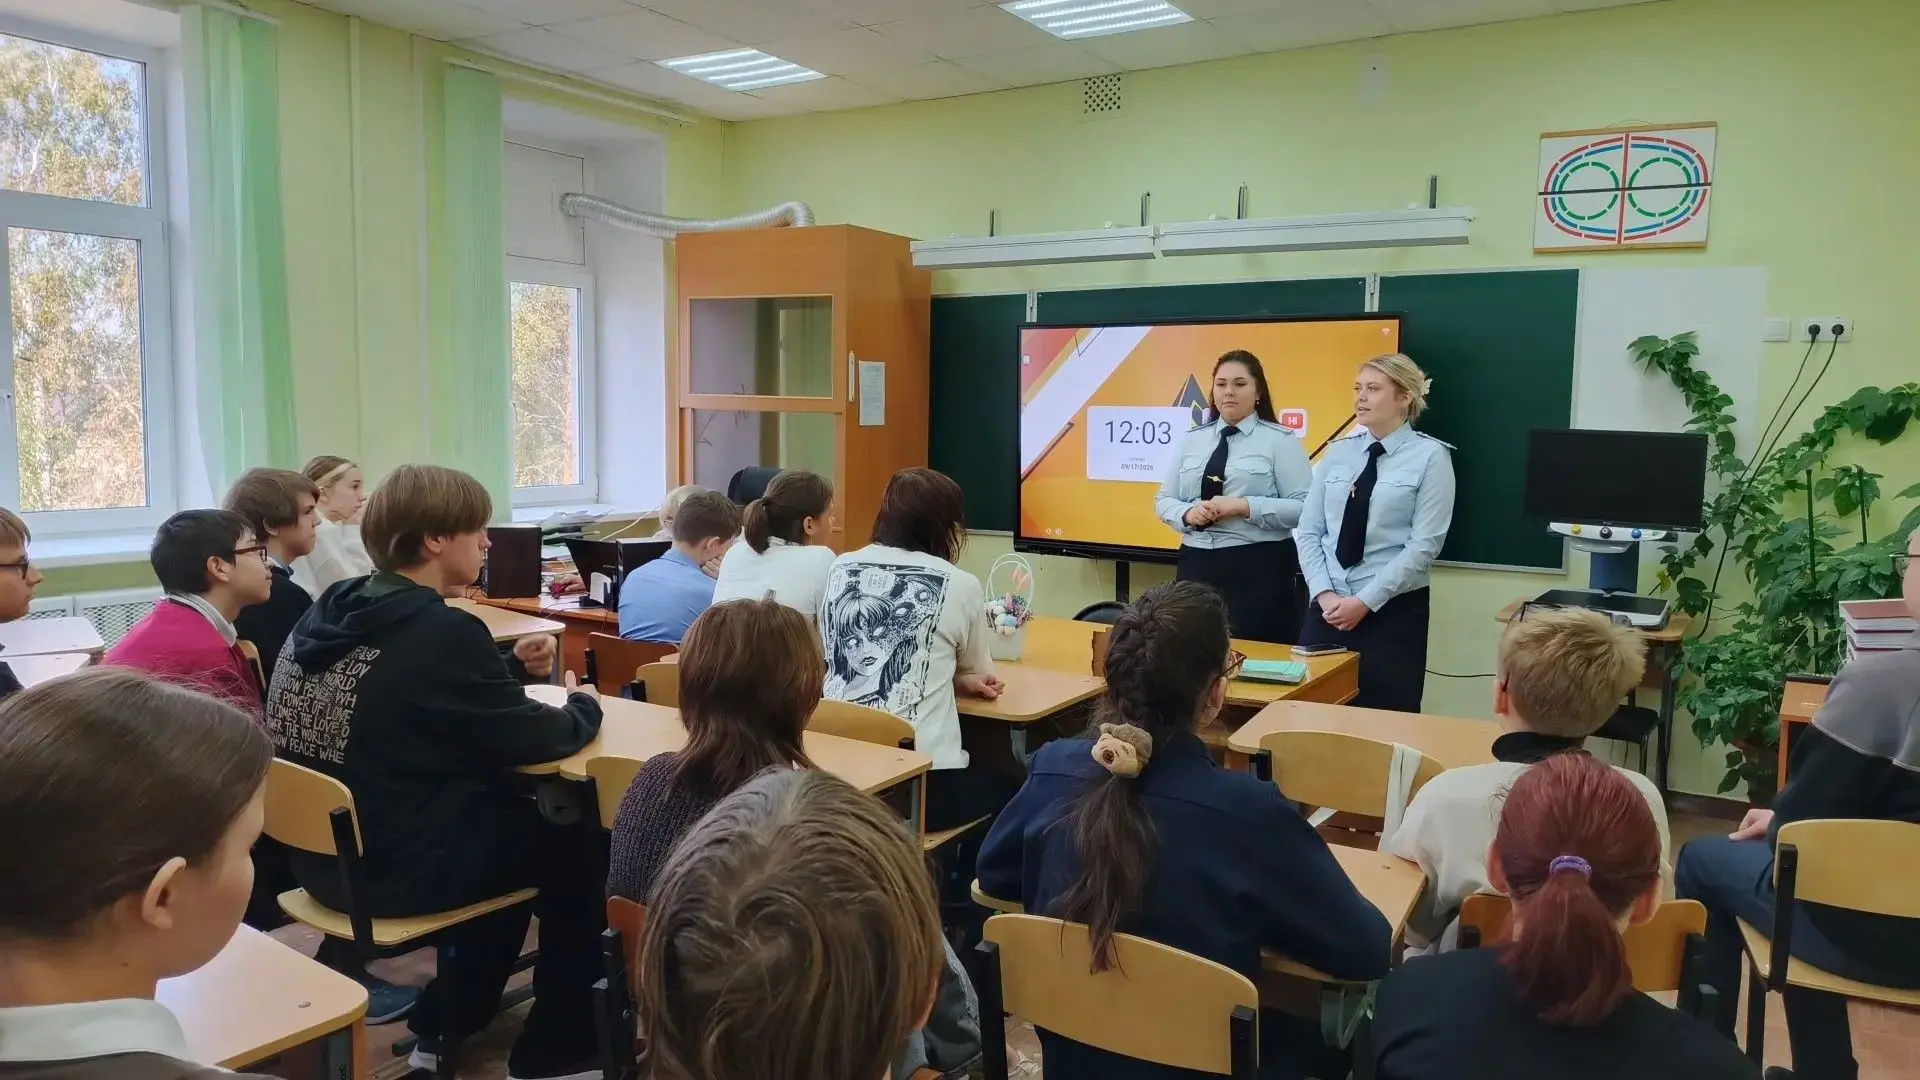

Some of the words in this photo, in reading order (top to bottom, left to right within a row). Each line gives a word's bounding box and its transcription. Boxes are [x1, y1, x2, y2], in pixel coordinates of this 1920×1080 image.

[1105, 420, 1171, 445] 12:03
[1120, 463, 1154, 472] 09/17/2026
[282, 690, 311, 713] POWER
[311, 700, 326, 717] OF
[274, 703, 298, 723] COMES
[299, 711, 313, 728] THE
[313, 715, 341, 734] LOVE
[285, 721, 300, 738] THE
[301, 727, 331, 746] WORLD
[289, 737, 316, 757] PEACE
[319, 747, 345, 764] WHE
